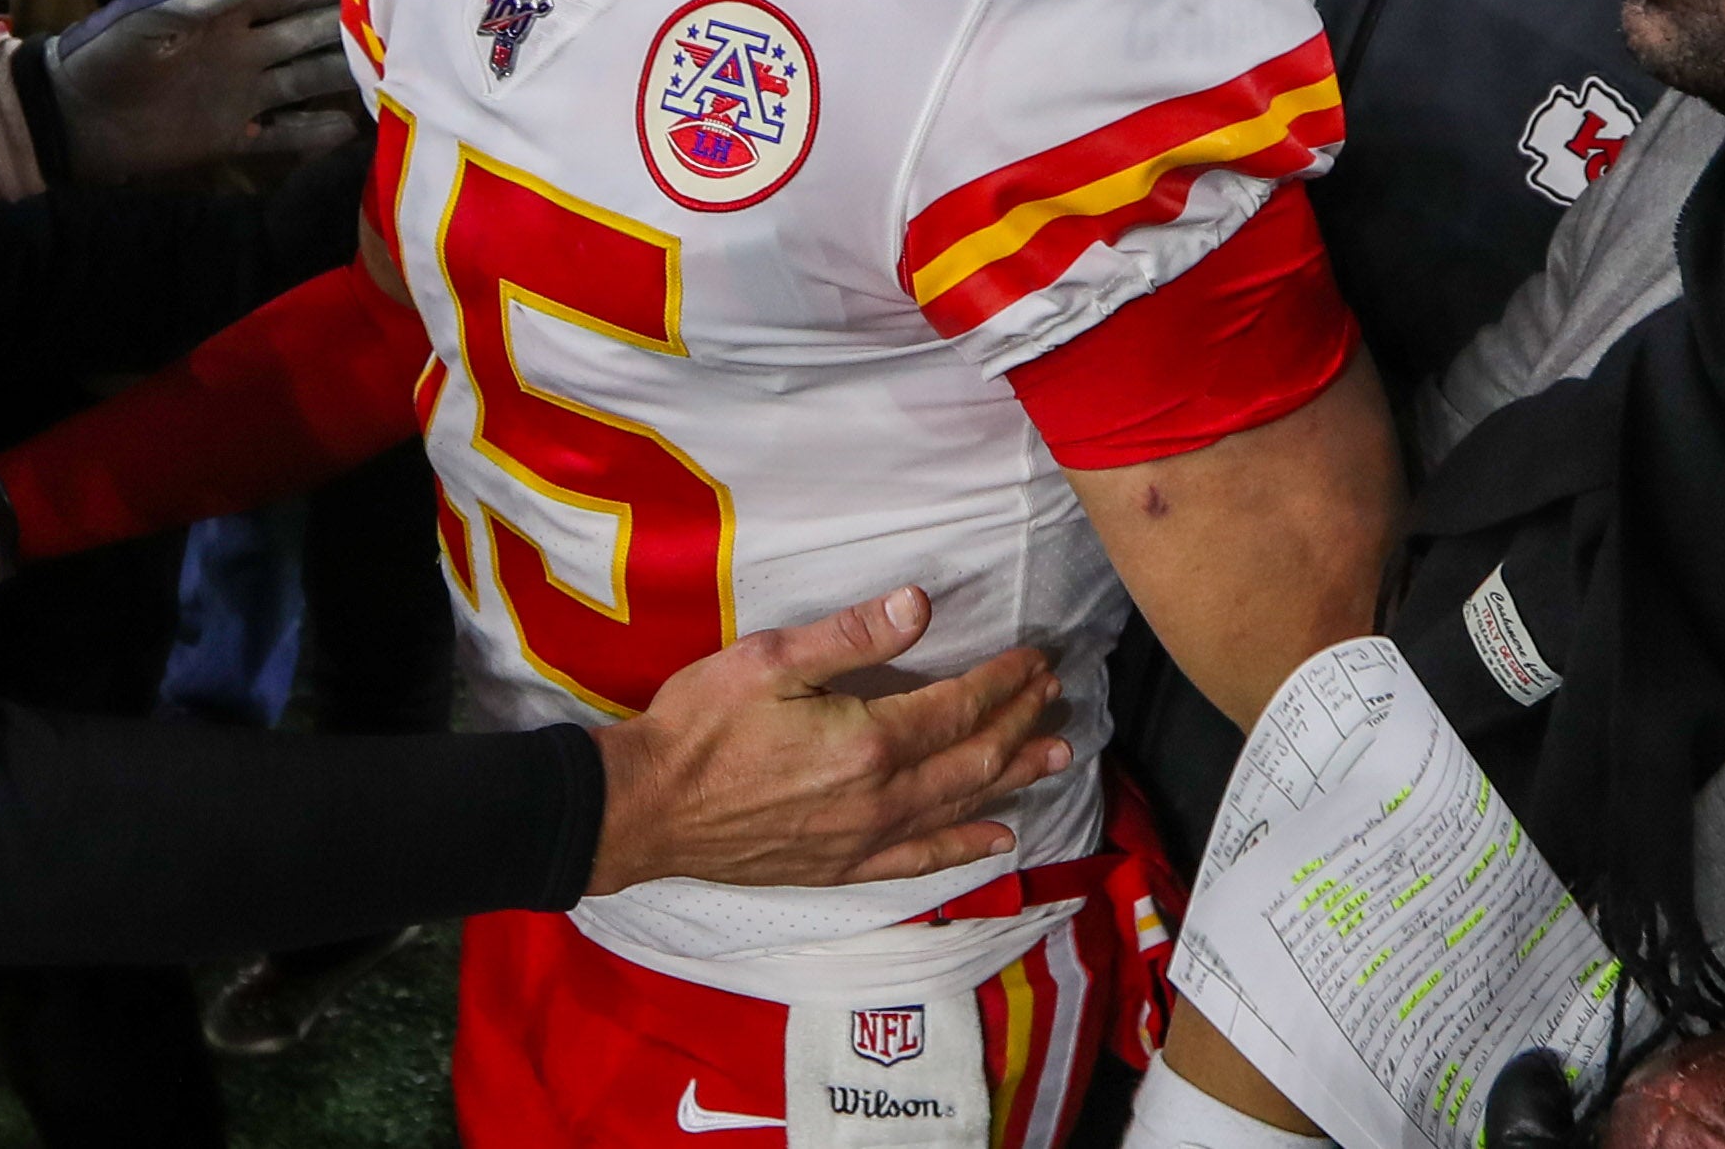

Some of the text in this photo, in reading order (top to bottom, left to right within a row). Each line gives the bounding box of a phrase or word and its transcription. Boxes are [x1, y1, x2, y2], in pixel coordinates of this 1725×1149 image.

[692, 131, 733, 162] LH
[1482, 608, 1531, 686] ITALY DESIGN
[856, 1011, 918, 1058] NFL
[827, 1085, 942, 1119] Wilson
